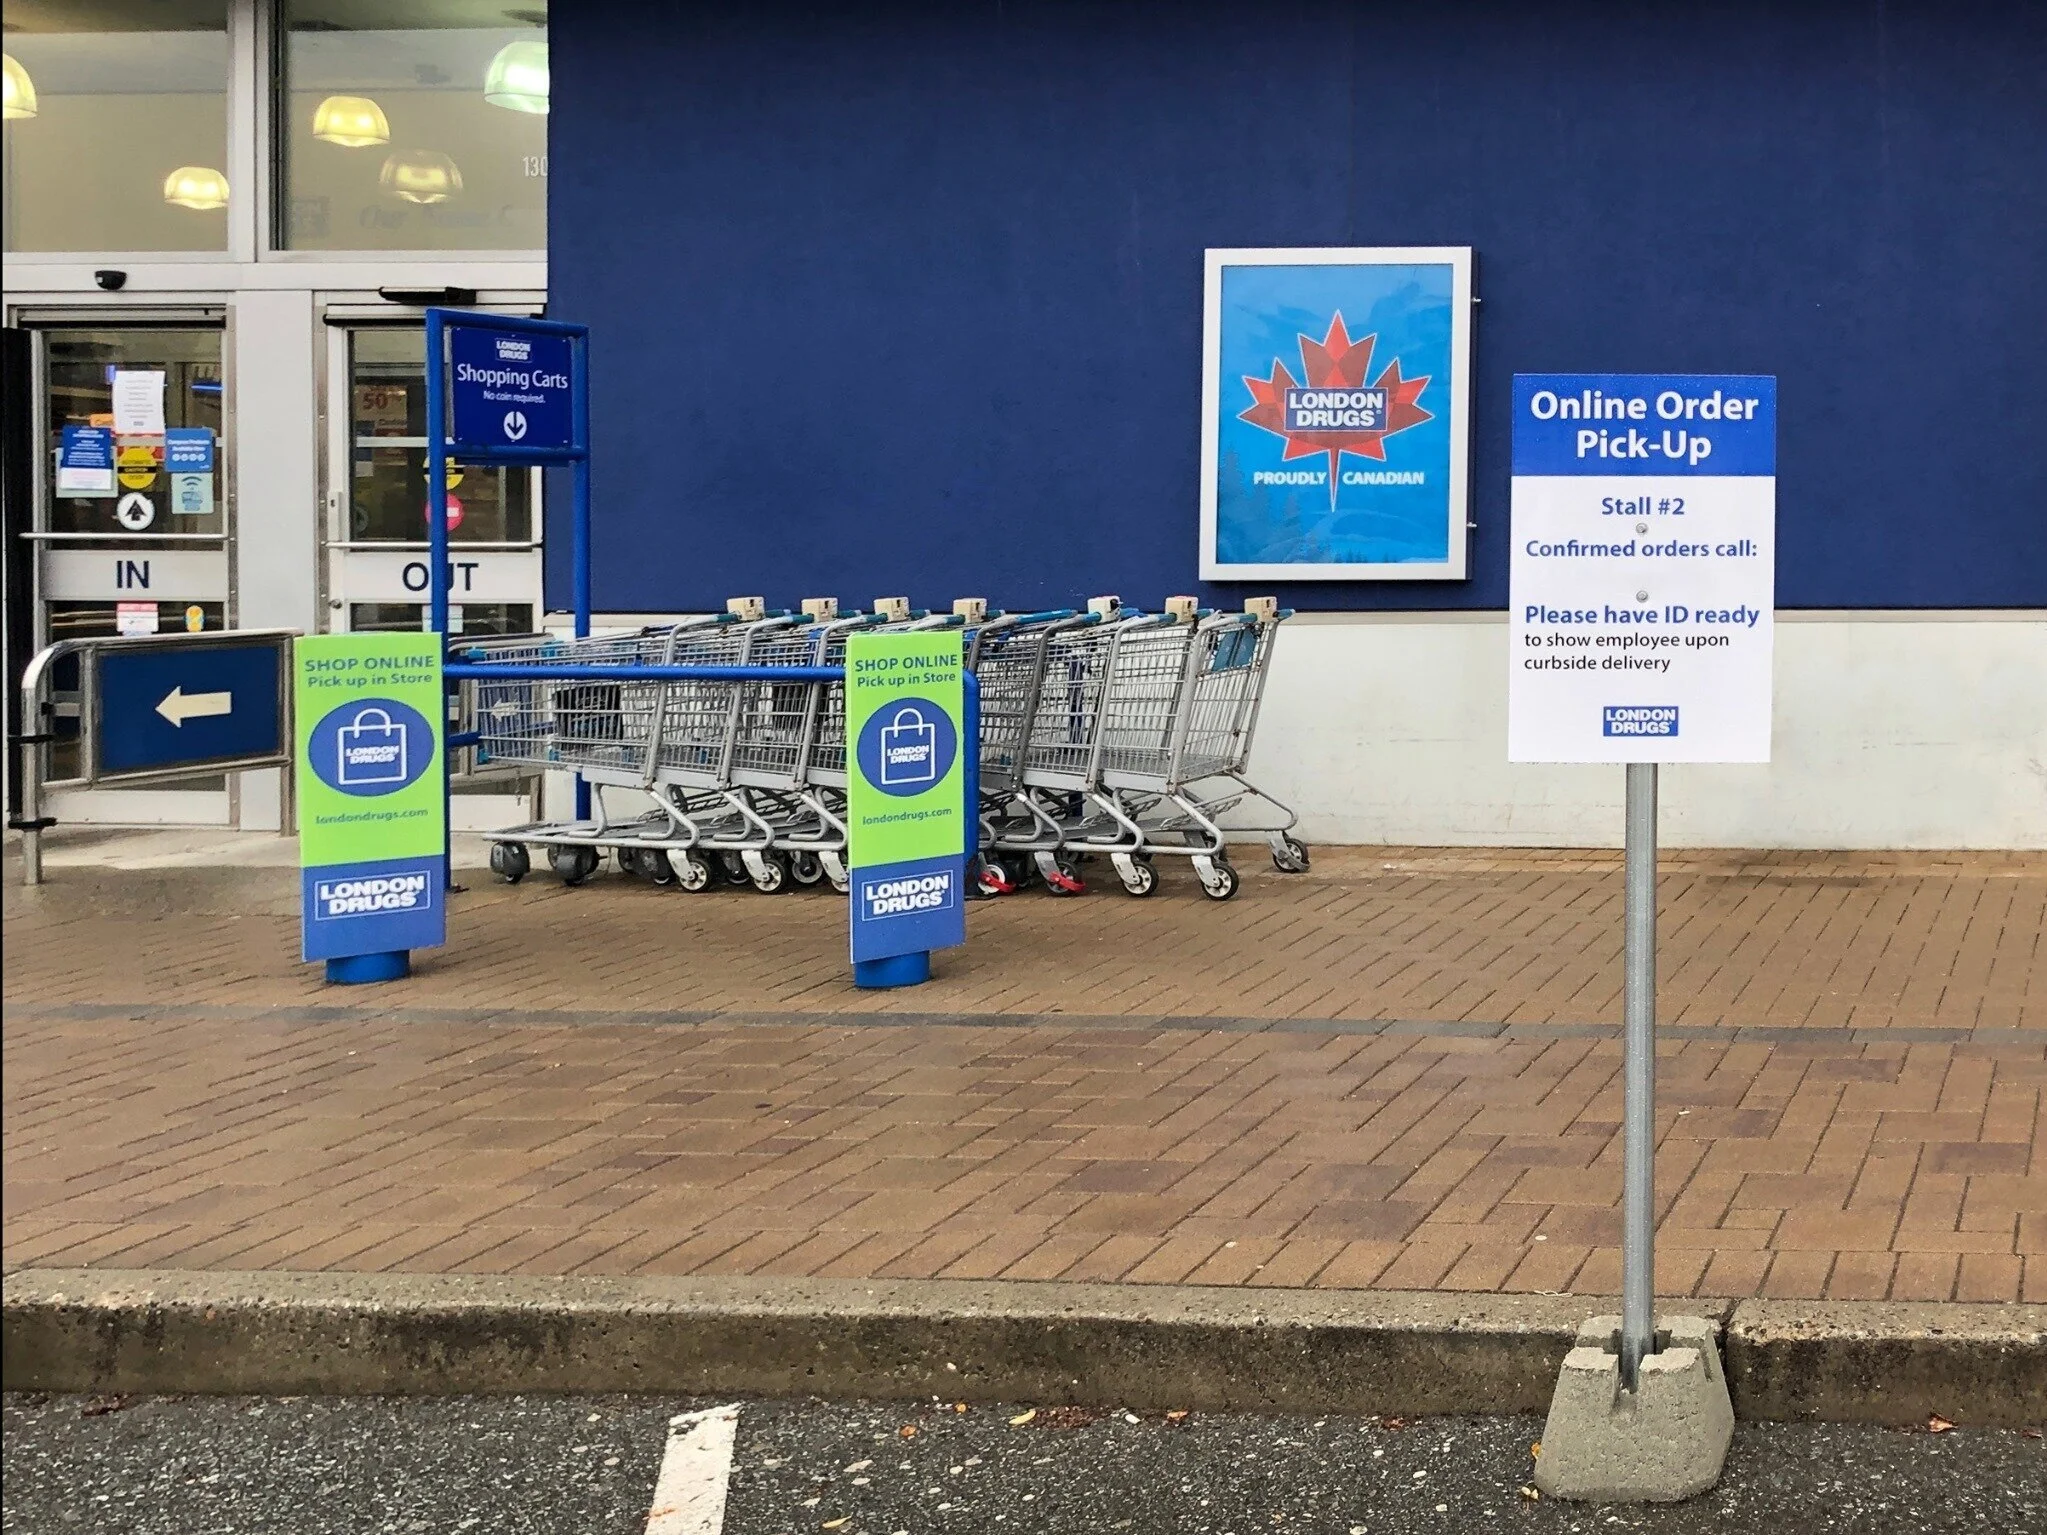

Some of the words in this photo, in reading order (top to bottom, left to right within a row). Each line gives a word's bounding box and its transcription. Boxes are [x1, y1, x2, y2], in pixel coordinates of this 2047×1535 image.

[496, 341, 531, 352] LONDON
[499, 350, 528, 360] DRUGS
[457, 363, 530, 390] Shopping
[532, 370, 569, 389] Carts
[483, 391, 495, 400] No
[1289, 392, 1384, 410] LONDON
[1530, 389, 1648, 420] Online
[1655, 389, 1760, 420] Order
[1576, 428, 1712, 466] Pick-Up
[1253, 471, 1327, 485] PROUDLY
[1342, 471, 1425, 485] CANADIAN
[1601, 496, 1652, 516] Stall
[1657, 498, 1685, 515] #2
[1526, 539, 1636, 557] Confirmed
[1641, 540, 1710, 557] orders
[1715, 540, 1758, 557] call:
[116, 561, 149, 588] IN
[1525, 605, 1598, 624] Please
[1604, 606, 1659, 624] have
[1664, 606, 1690, 623] ID
[1695, 605, 1760, 628] ready
[1524, 634, 1542, 647] to
[1546, 632, 1591, 647] show
[1595, 632, 1681, 650] employee
[1685, 634, 1730, 650] upon
[305, 658, 358, 672] SHOP
[364, 655, 434, 670] ONLINE
[855, 658, 899, 672] SHOP
[902, 654, 958, 670] ONLINE
[1524, 656, 1597, 670] curbside
[1601, 656, 1671, 673] delivery
[308, 675, 341, 688] Pick
[346, 676, 368, 688] up
[371, 674, 387, 685] in
[391, 672, 433, 685] Store
[857, 676, 885, 688] Pick
[888, 676, 906, 688] up
[908, 673, 921, 685] in
[923, 672, 956, 684] Store
[1605, 708, 1676, 722] LONDON
[345, 745, 400, 757] LONDON
[349, 754, 396, 765] DRUGS
[886, 745, 930, 757] LONDON
[890, 755, 927, 764] DRUGS
[315, 808, 429, 824] londondrugs.com
[862, 807, 952, 826] londondrugs.com
[320, 875, 425, 900] LONDON
[866, 874, 949, 901] LONDON
[328, 891, 417, 915] DRUGS
[873, 891, 943, 915] DRUGS
